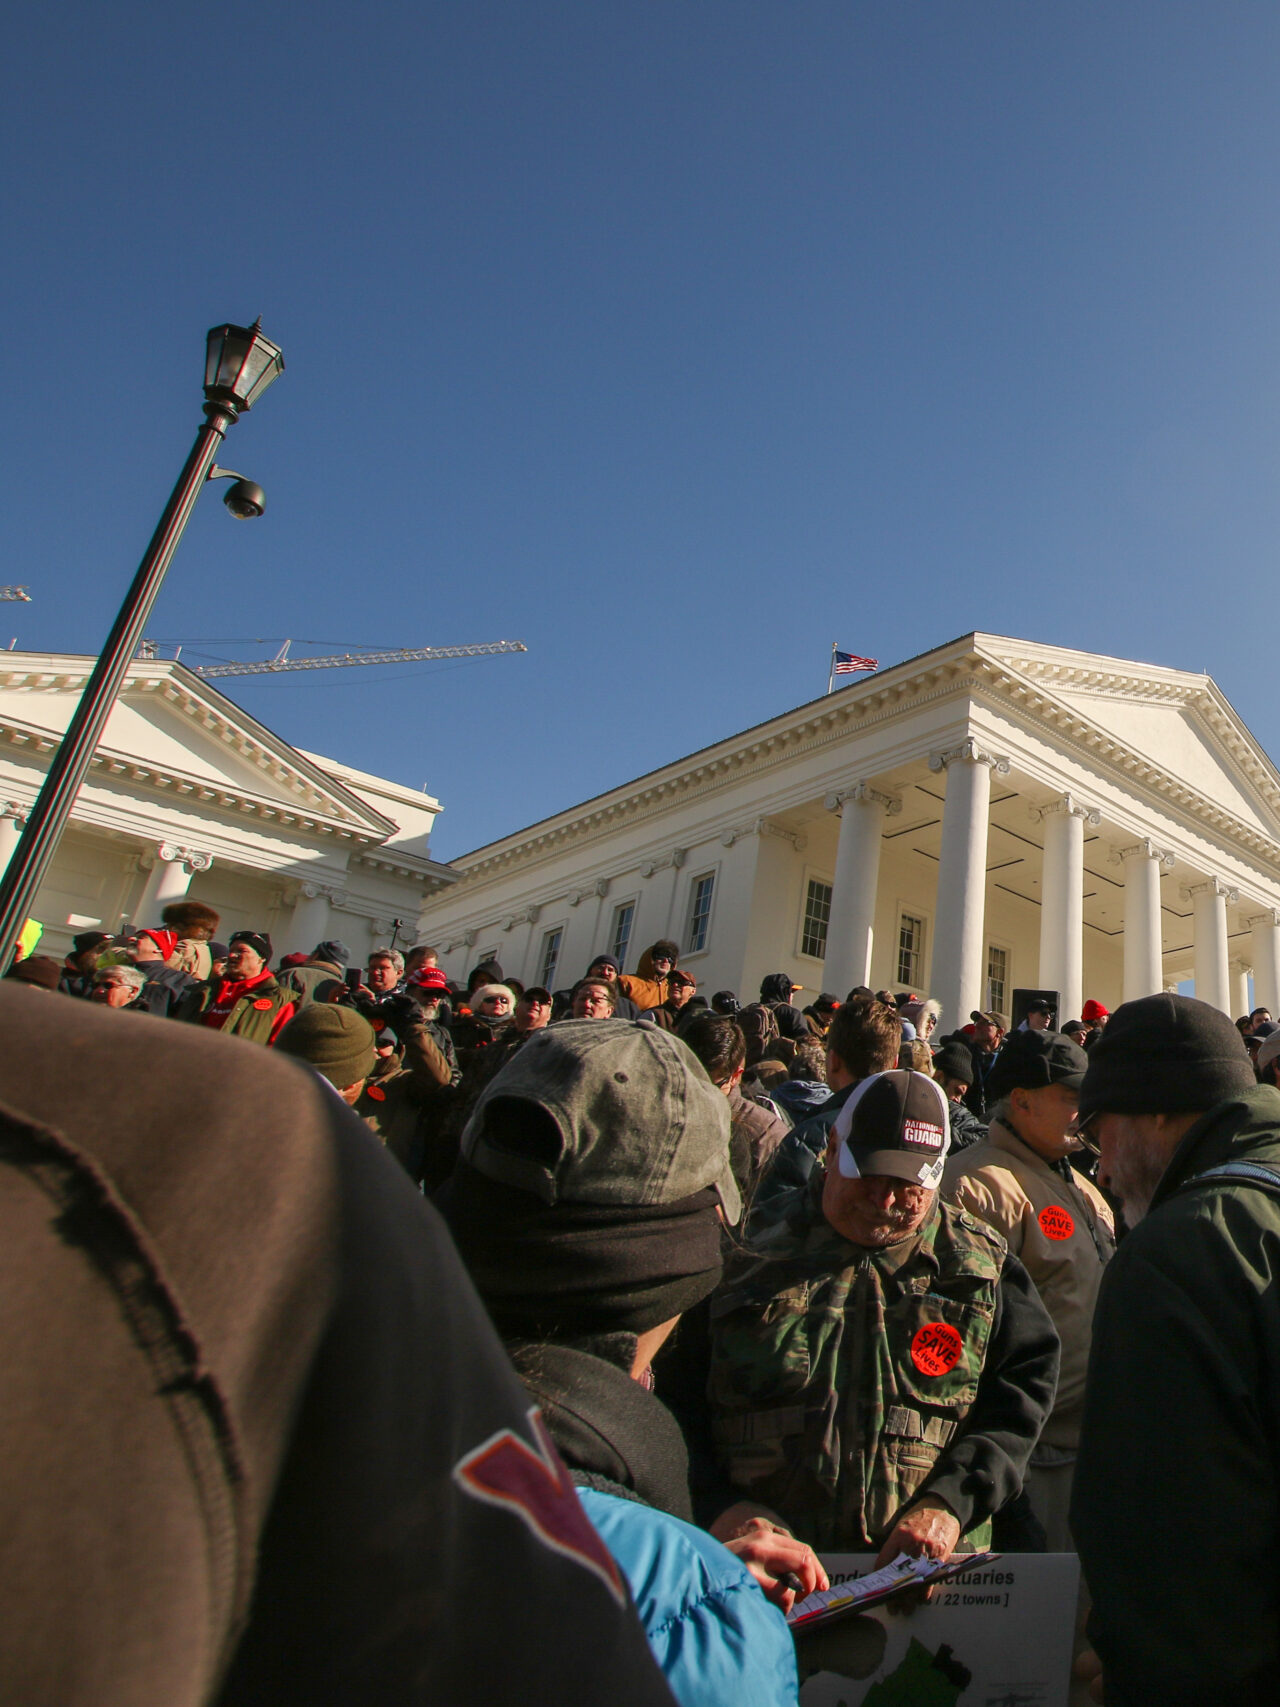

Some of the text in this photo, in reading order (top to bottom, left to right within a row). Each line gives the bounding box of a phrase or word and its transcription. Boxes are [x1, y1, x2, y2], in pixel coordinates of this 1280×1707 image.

[904, 1127, 942, 1147] GUARD
[1047, 1207, 1069, 1220] Guns
[1041, 1215, 1072, 1232] SAVE
[1044, 1226, 1067, 1238] Lives
[935, 1324, 959, 1348] Guns
[918, 1330, 957, 1367] SAVE
[915, 1346, 940, 1372] Lives
[944, 1593, 960, 1606] 22
[963, 1594, 1001, 1606] towns
